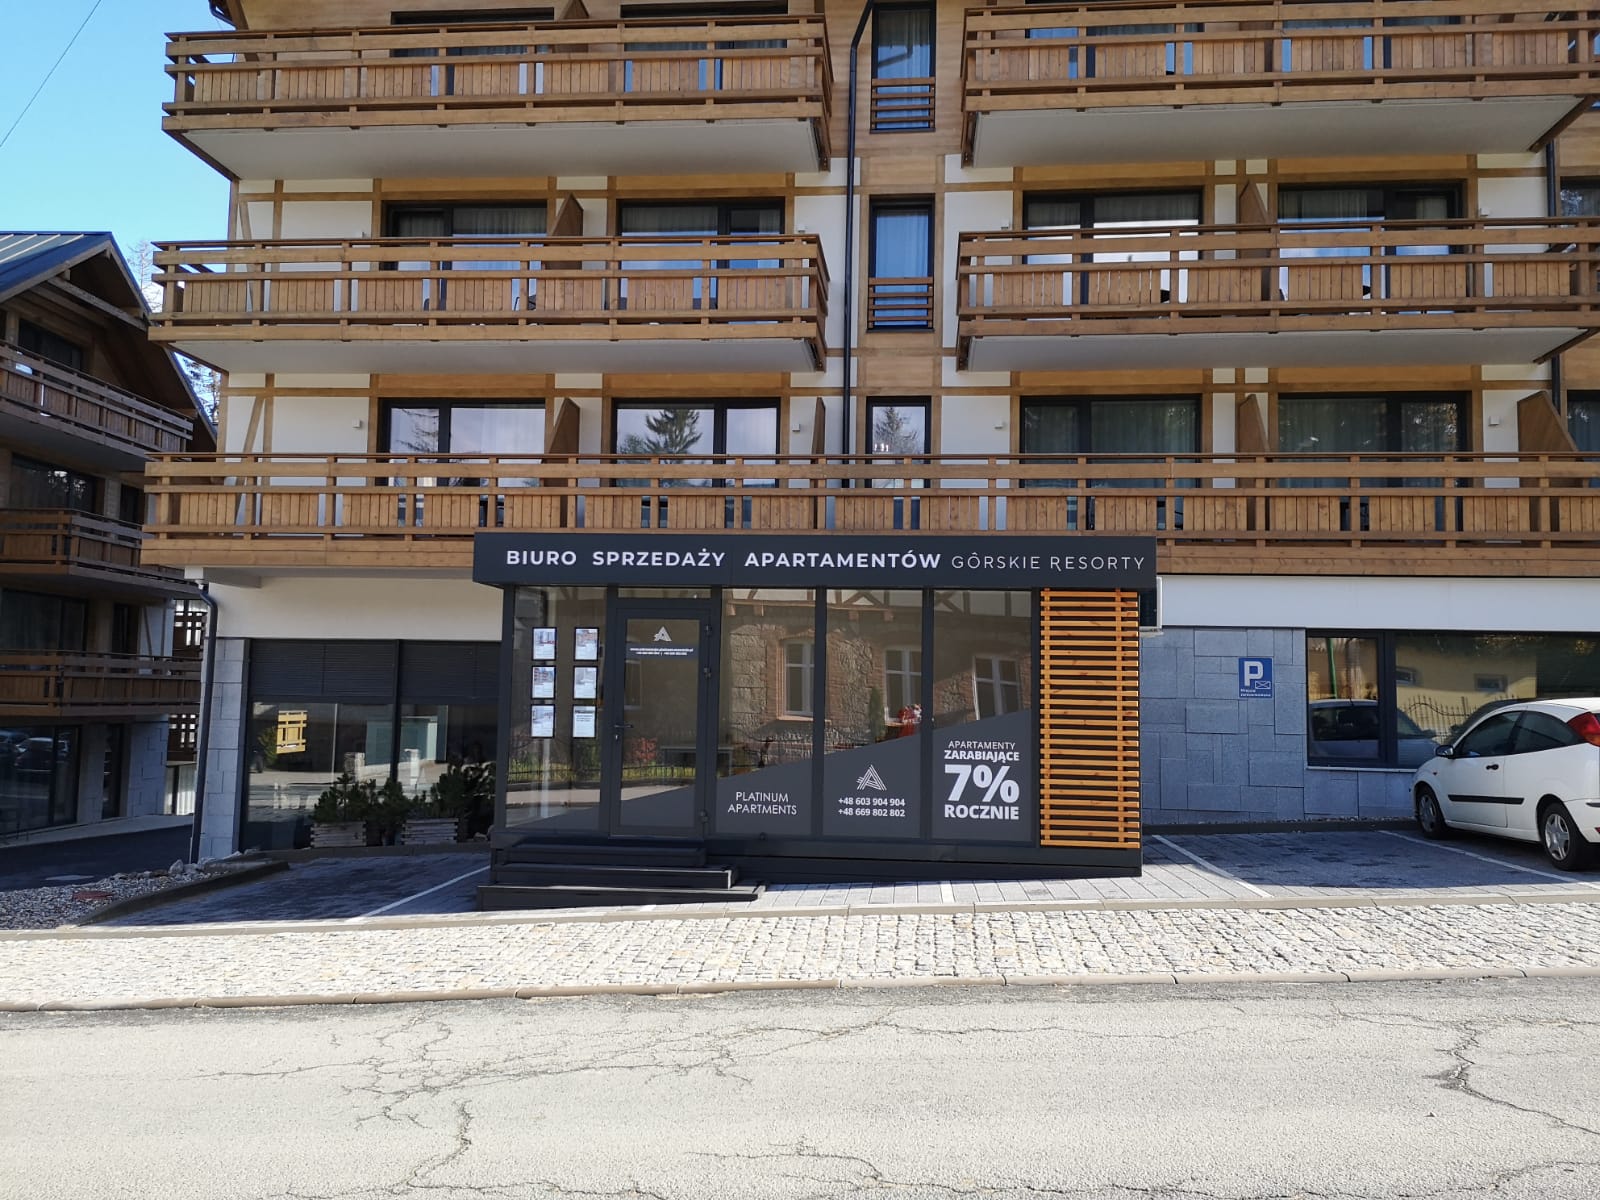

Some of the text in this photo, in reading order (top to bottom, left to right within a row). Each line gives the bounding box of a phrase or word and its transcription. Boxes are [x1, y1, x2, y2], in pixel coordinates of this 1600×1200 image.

[506, 550, 577, 566] BIURO
[592, 547, 726, 567] SPRZEDAŻY
[744, 549, 941, 569] APARTAMENTÓW
[1050, 555, 1145, 572] RESORTY
[1244, 660, 1264, 687] P
[947, 740, 1016, 751] APARTAMENTY
[943, 749, 1020, 763] ZARABIAJĄCE
[944, 764, 1020, 804] 7%
[735, 791, 789, 803] PLATINUM
[838, 796, 906, 807] +48 603 904 904
[727, 803, 797, 815] APARTMENTS
[838, 807, 906, 818] +48 669 802 802
[944, 804, 1020, 821] ROCZNIE
